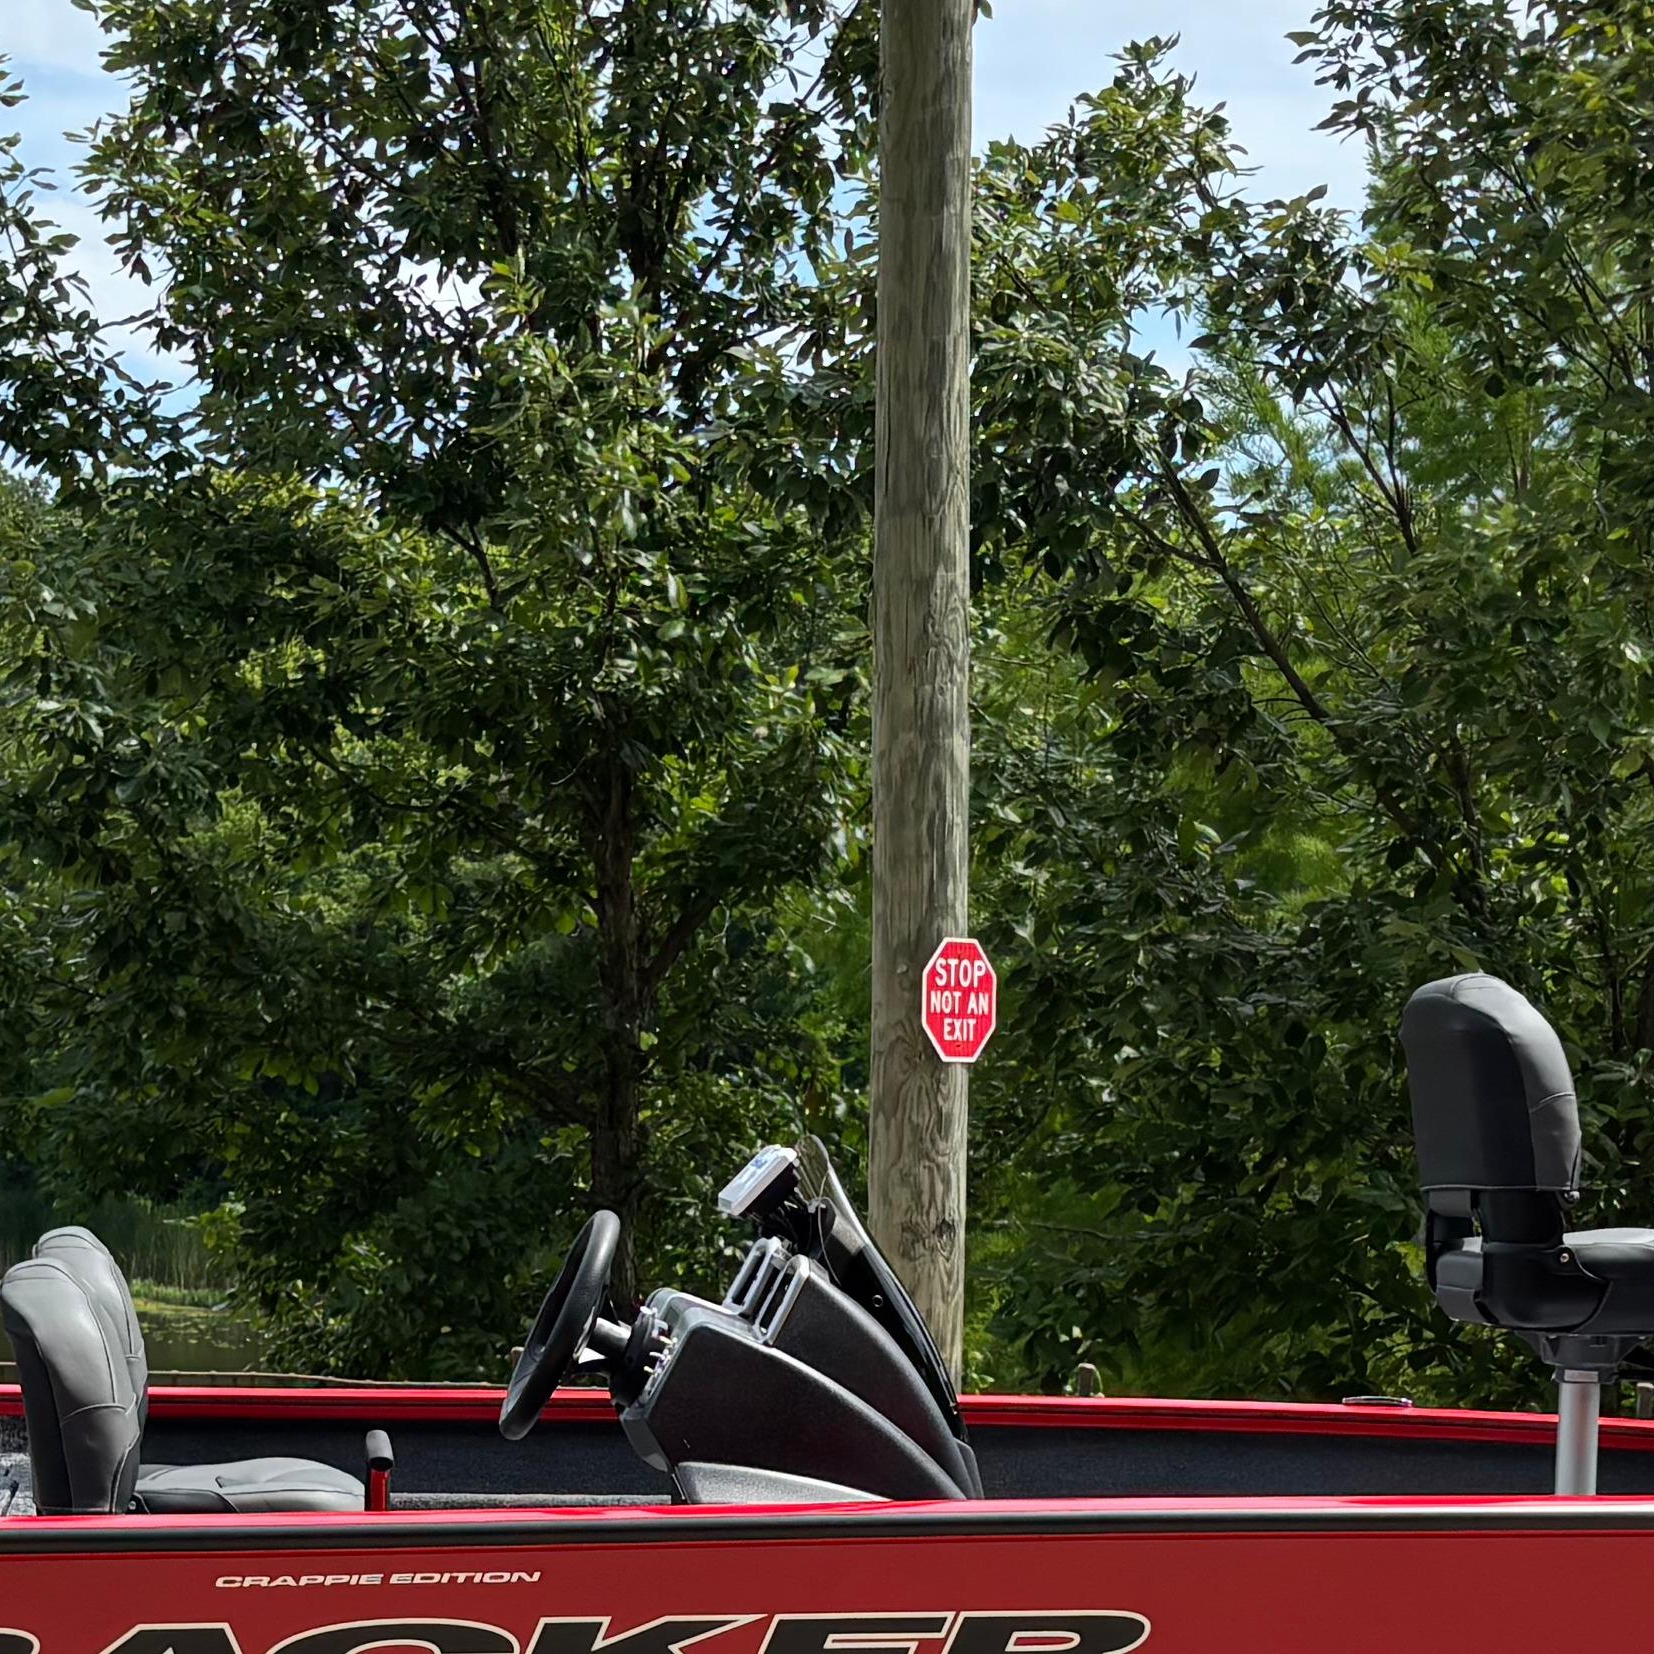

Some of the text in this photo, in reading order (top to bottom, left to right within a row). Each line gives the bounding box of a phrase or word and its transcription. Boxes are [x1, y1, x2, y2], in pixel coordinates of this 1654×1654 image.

[935, 958, 987, 987] STOP
[930, 990, 989, 1015] NOT AN
[943, 1018, 977, 1041] EXIT
[215, 1571, 542, 1588] CRAPPIE EDITION
